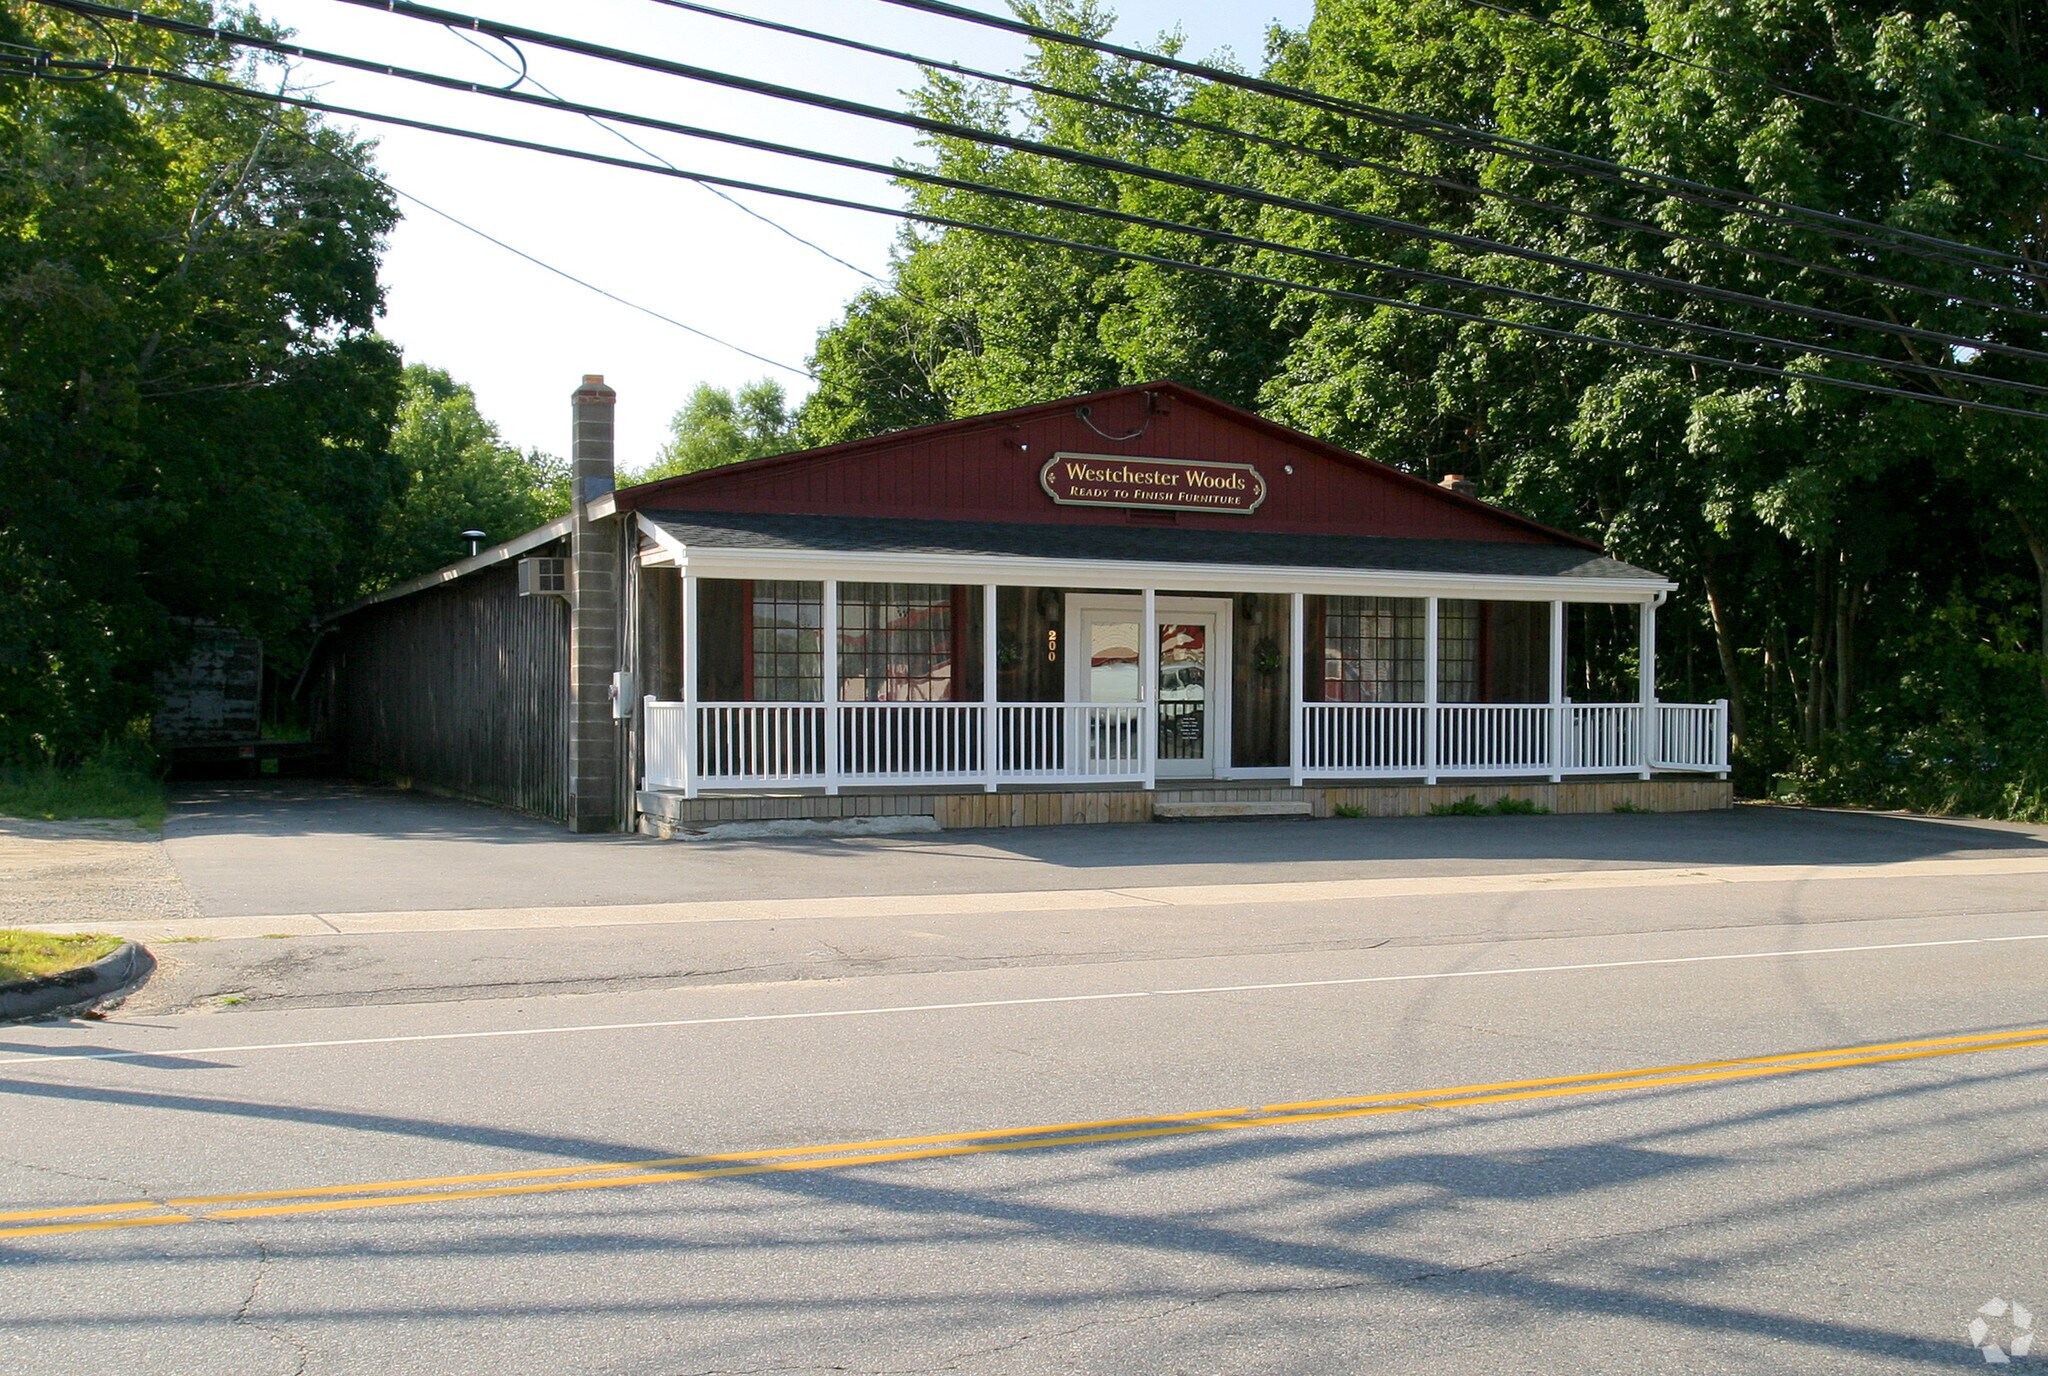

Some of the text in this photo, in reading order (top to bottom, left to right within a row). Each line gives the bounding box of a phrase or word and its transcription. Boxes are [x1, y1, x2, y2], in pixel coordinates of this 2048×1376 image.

[1065, 462, 1246, 490] Westchester Woods
[1069, 485, 1109, 498] READY
[1134, 489, 1174, 501] FINISH
[1178, 492, 1241, 505] FURNITURE
[1048, 630, 1057, 662] 200
